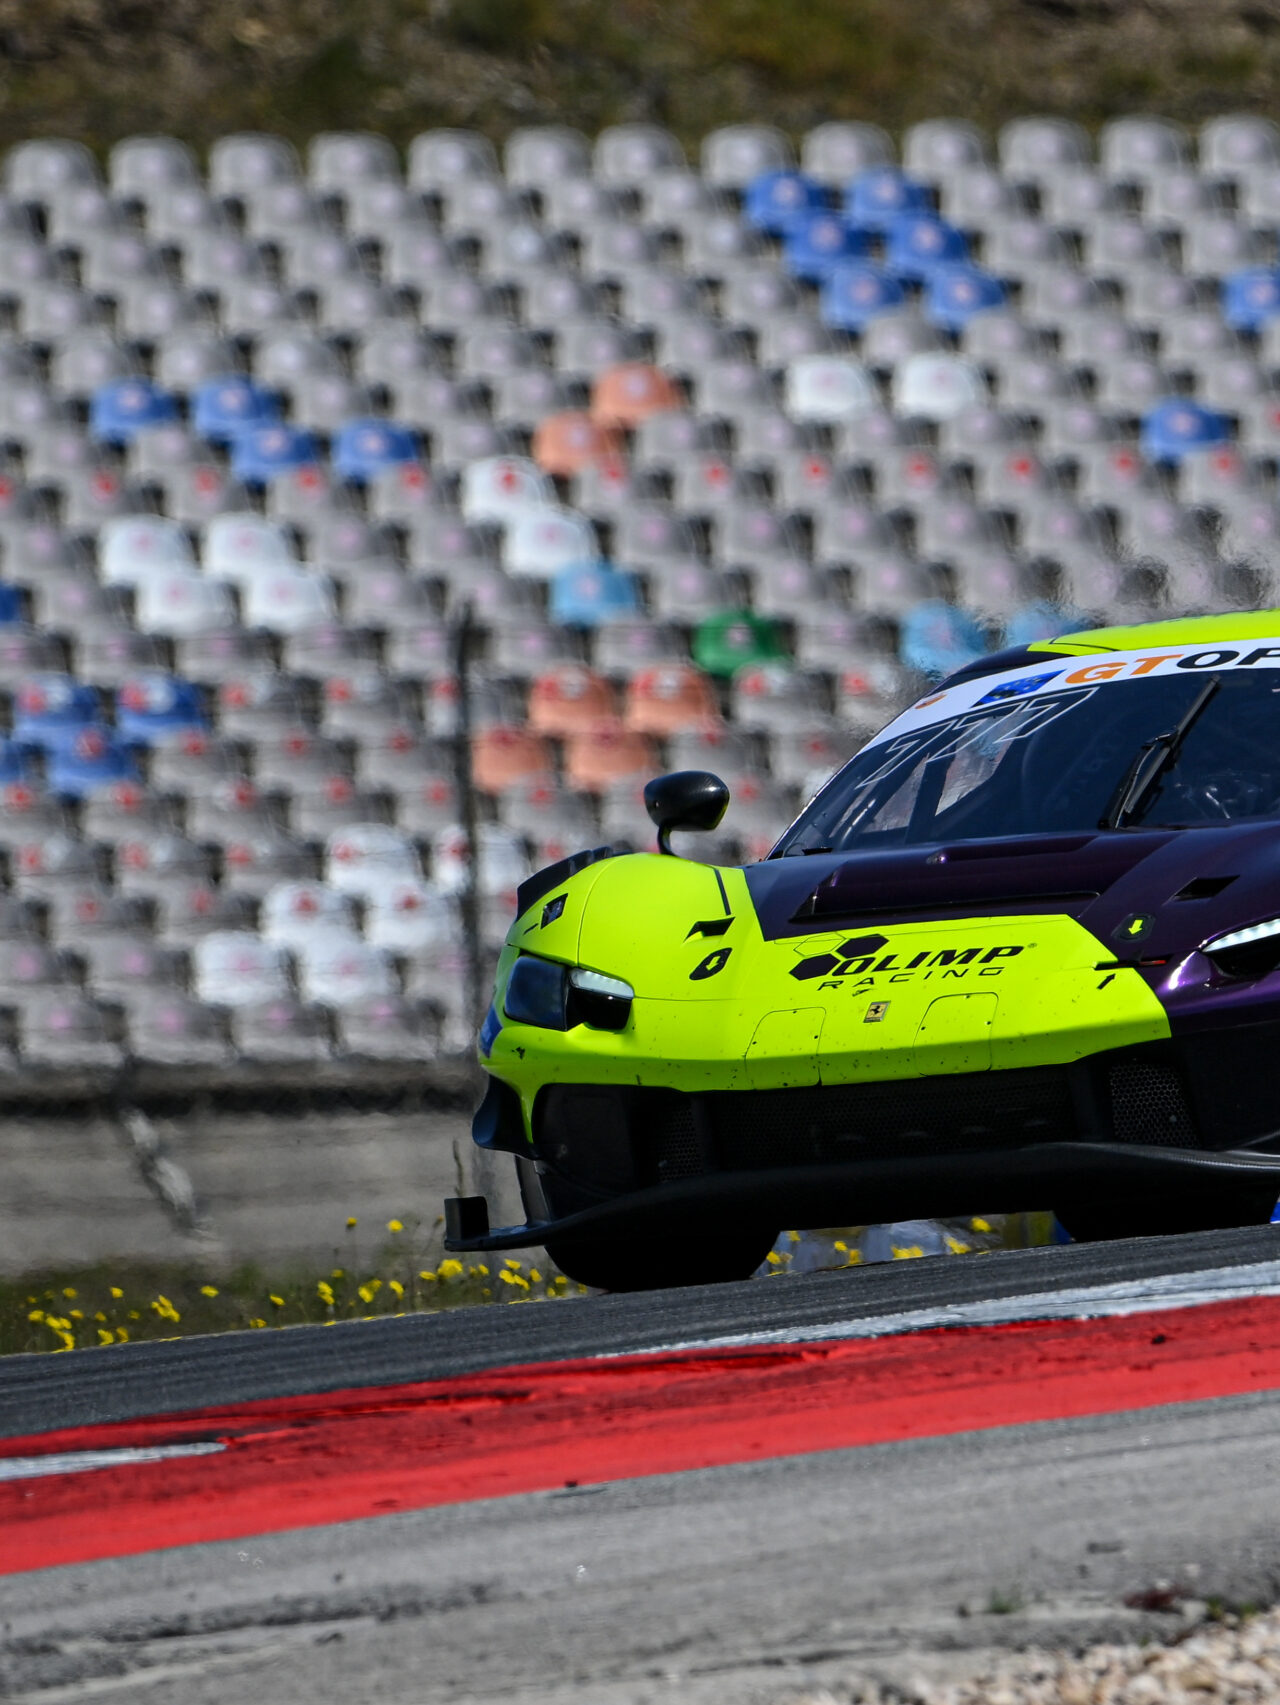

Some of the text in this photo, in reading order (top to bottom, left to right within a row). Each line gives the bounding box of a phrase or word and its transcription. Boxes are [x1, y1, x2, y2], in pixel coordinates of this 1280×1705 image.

[855, 686, 1100, 790] 777
[831, 946, 1025, 977] OLIMP
[817, 967, 1005, 991] RACING
